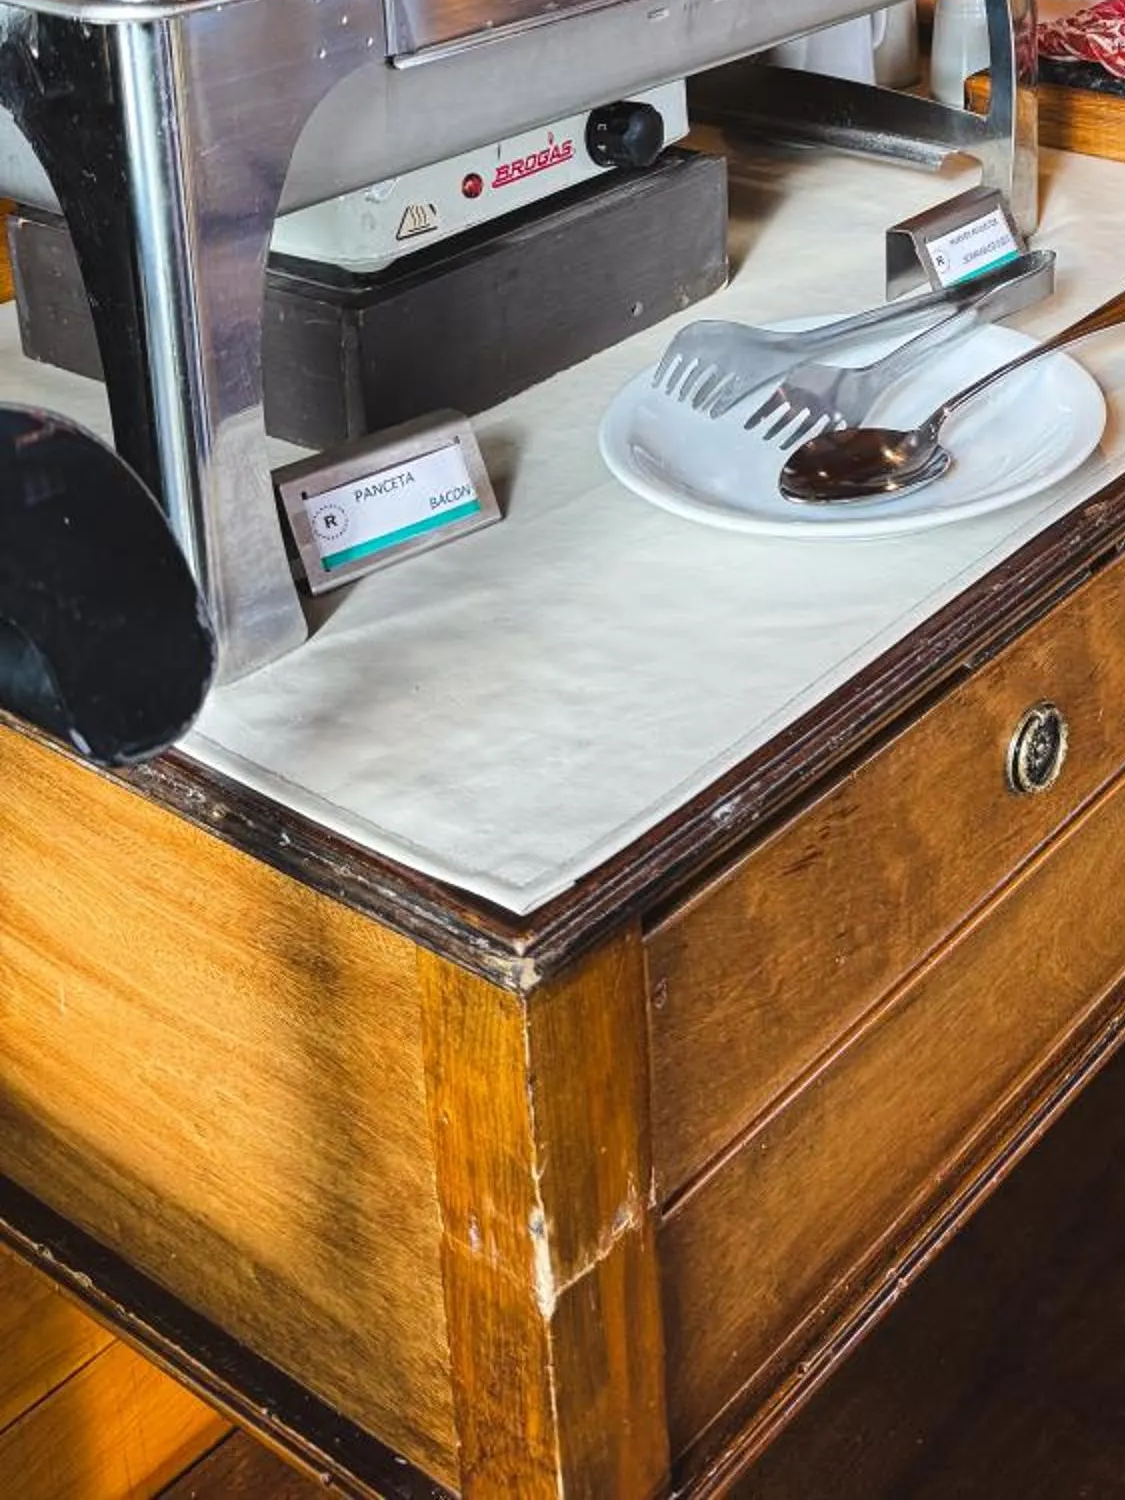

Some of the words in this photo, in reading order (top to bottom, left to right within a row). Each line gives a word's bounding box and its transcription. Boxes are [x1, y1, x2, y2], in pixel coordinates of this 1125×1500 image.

[495, 139, 574, 183] BROGAS
[354, 471, 415, 502] PANCETA
[429, 484, 471, 510] BACON
[324, 514, 338, 529] R
